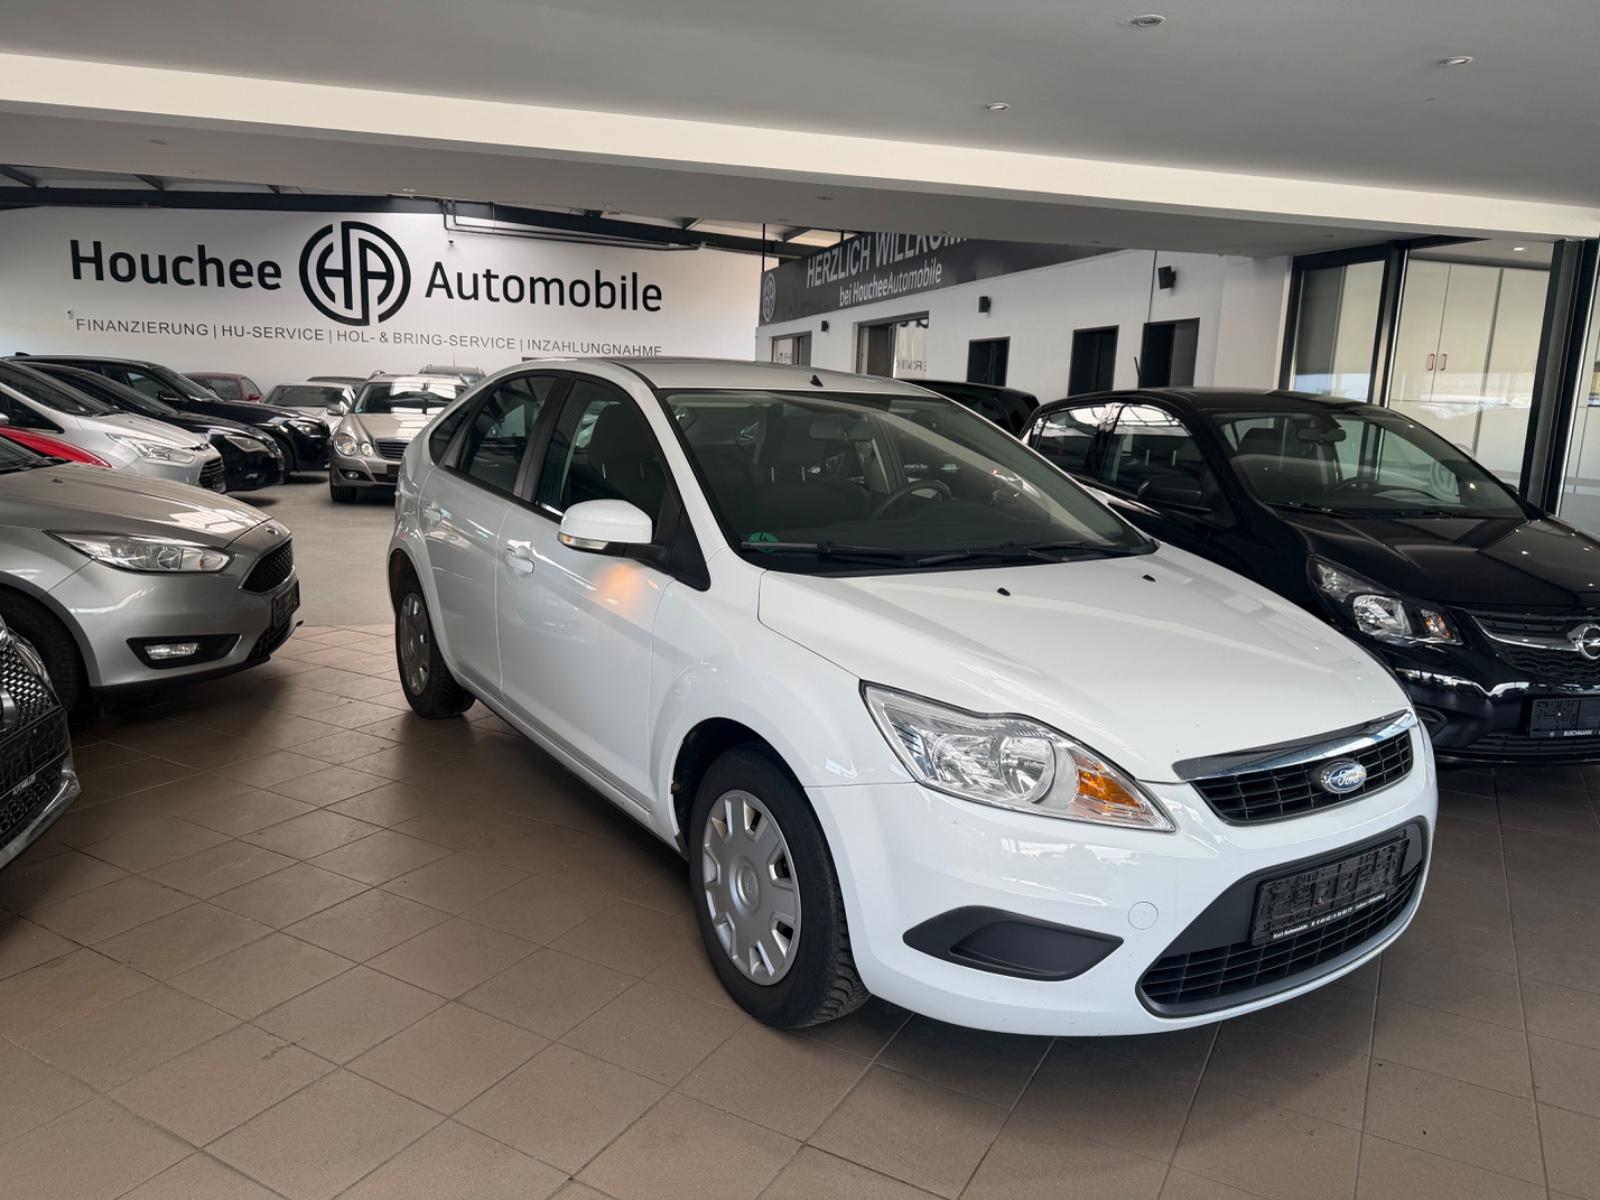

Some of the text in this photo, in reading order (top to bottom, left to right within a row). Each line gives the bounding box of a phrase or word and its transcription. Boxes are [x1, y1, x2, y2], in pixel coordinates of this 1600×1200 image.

[70, 239, 662, 312] Houchee Automobile
[806, 233, 871, 288] HERZLICH
[839, 285, 853, 307] bei
[76, 318, 209, 336] FINANZIERUNG
[222, 325, 324, 341] HU-SERVICE
[337, 330, 375, 343] HOL-
[379, 332, 389, 343] &
[393, 332, 516, 350] BRING-SERVICE
